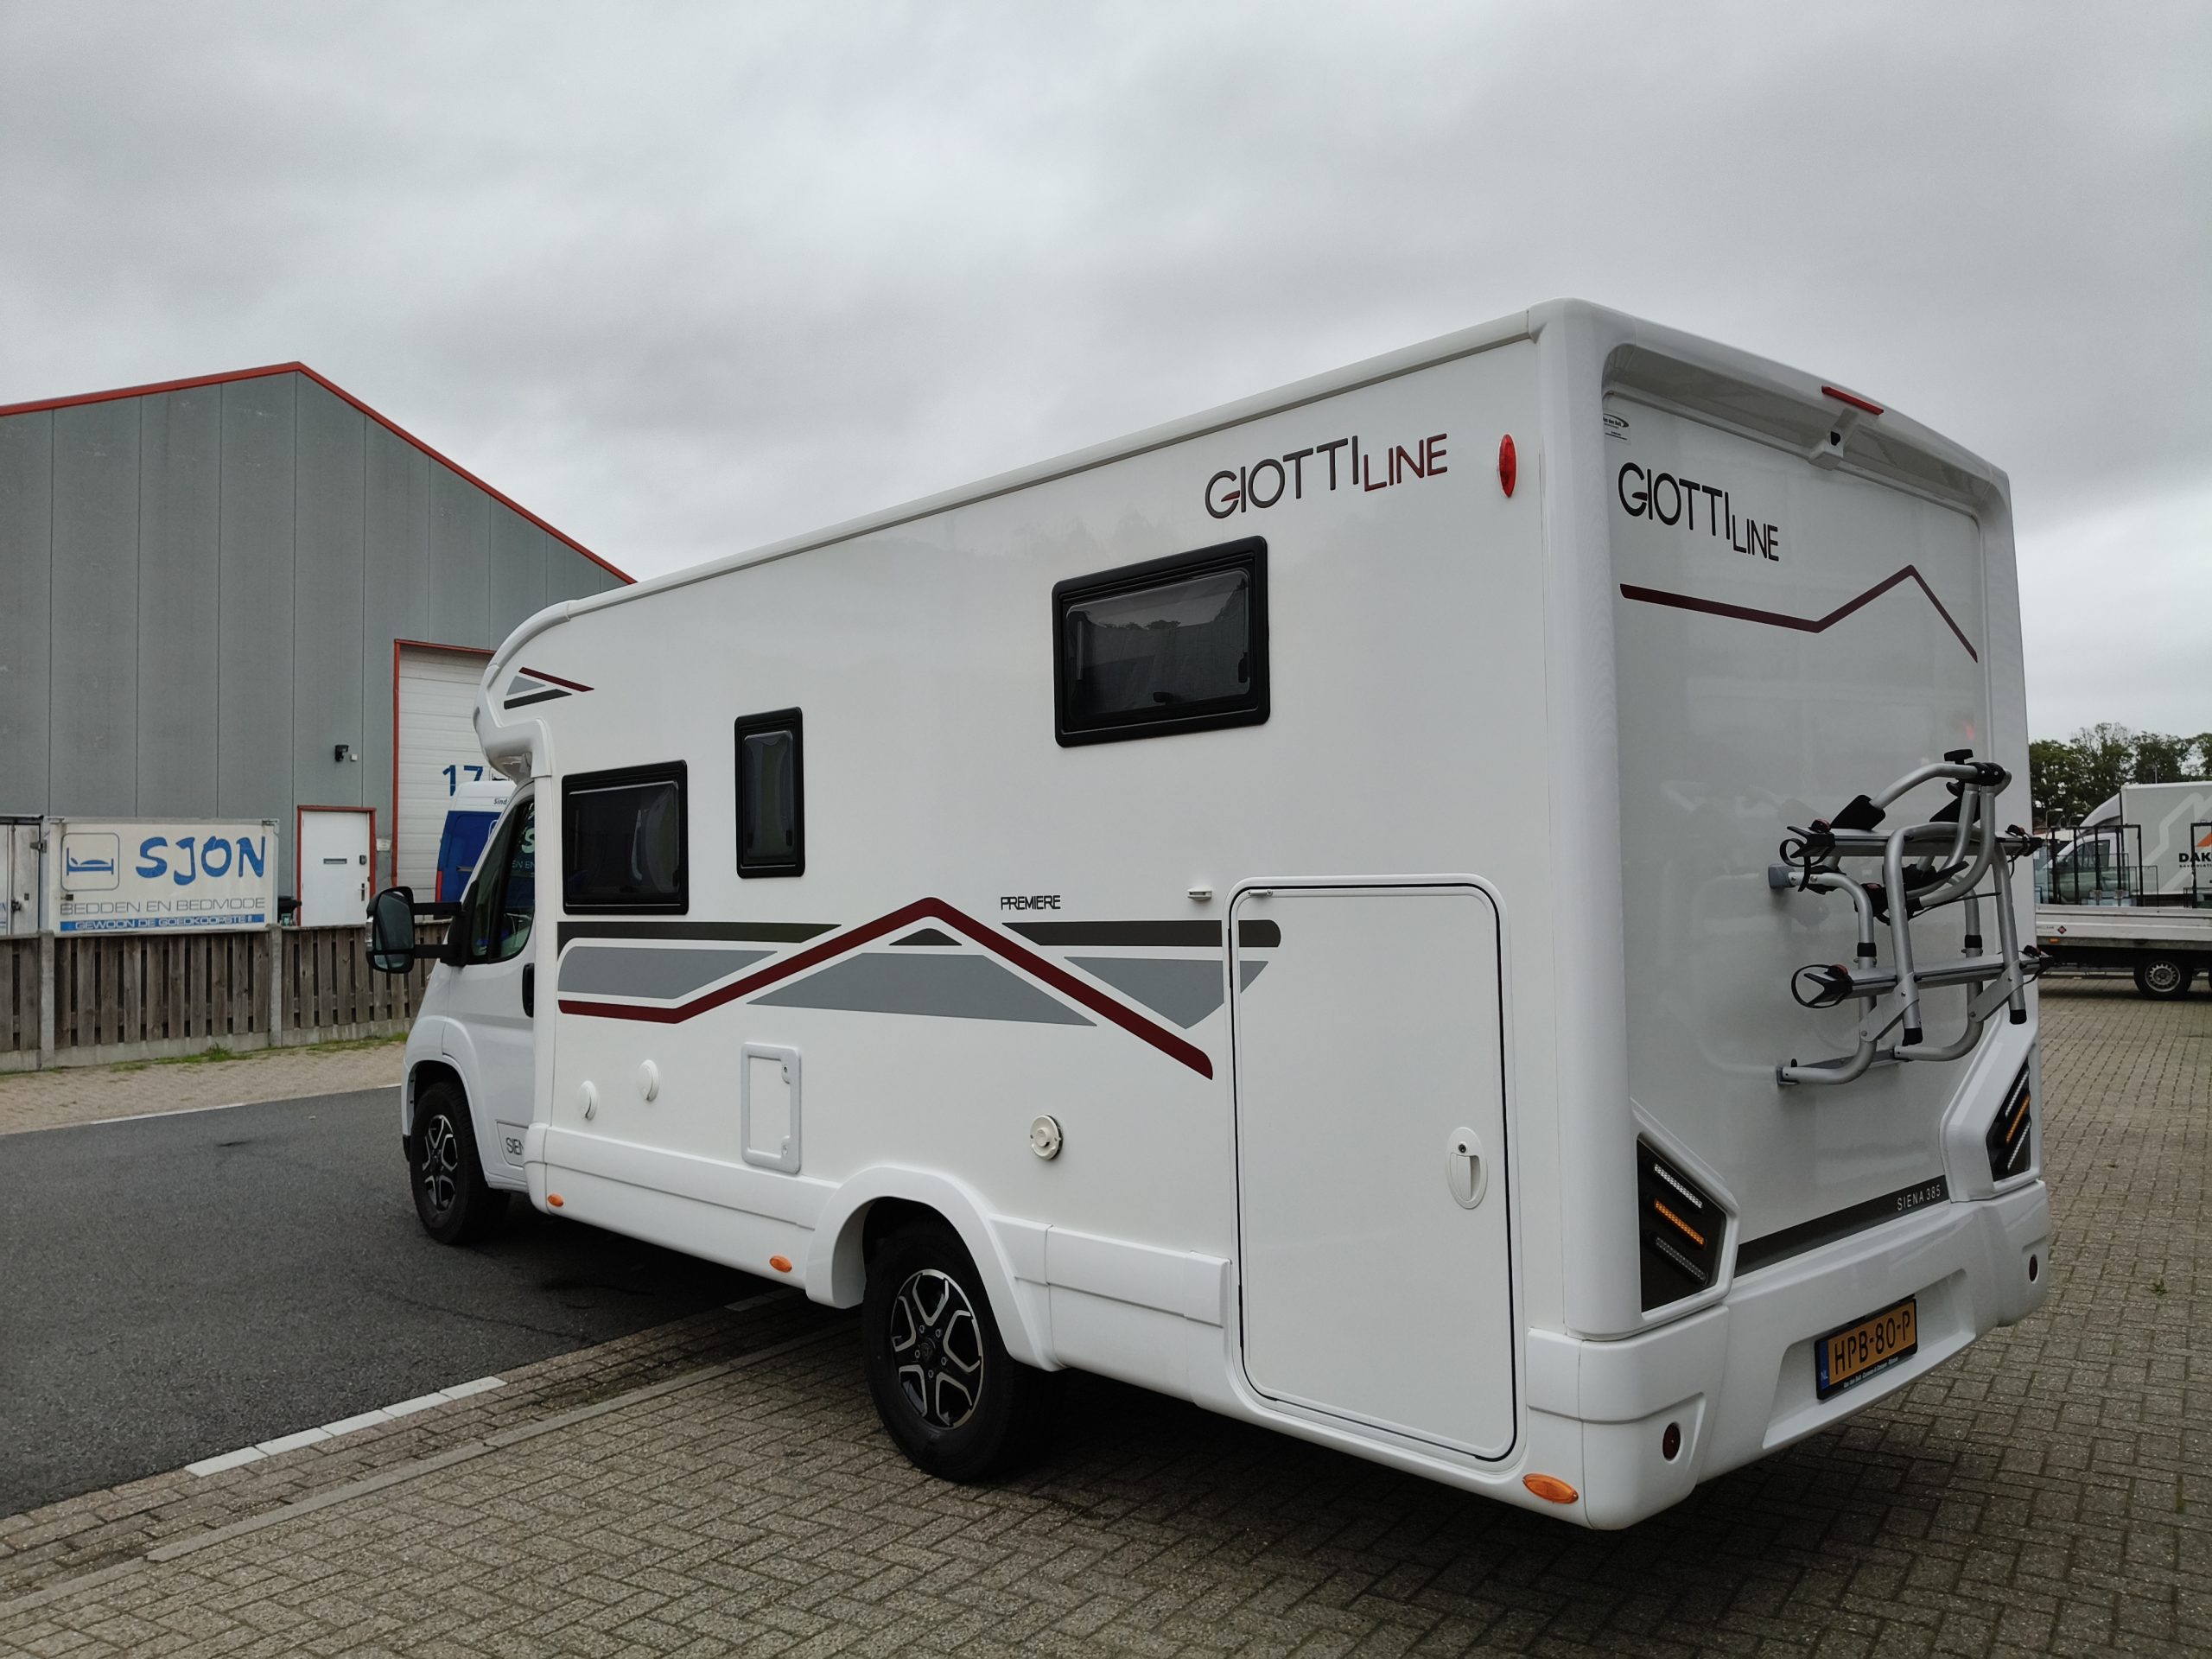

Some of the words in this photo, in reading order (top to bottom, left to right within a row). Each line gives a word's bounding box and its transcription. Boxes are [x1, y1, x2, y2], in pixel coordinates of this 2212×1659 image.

[1205, 433, 1448, 519] GIOTTILINE
[1618, 461, 1780, 562] GIOTTILINE
[442, 765, 484, 797] 17
[135, 835, 266, 886] SJON
[60, 901, 141, 916] BEDDEN
[146, 899, 171, 912] EN
[176, 897, 265, 912] BEDMODE
[1000, 894, 1062, 911] PREMIERE
[75, 918, 136, 931] GEWOON
[137, 918, 156, 928] DE
[1896, 1190, 1925, 1211] SIENA
[1925, 1184, 1942, 1201] 385
[1834, 1310, 1911, 1376] HPB-80-P
